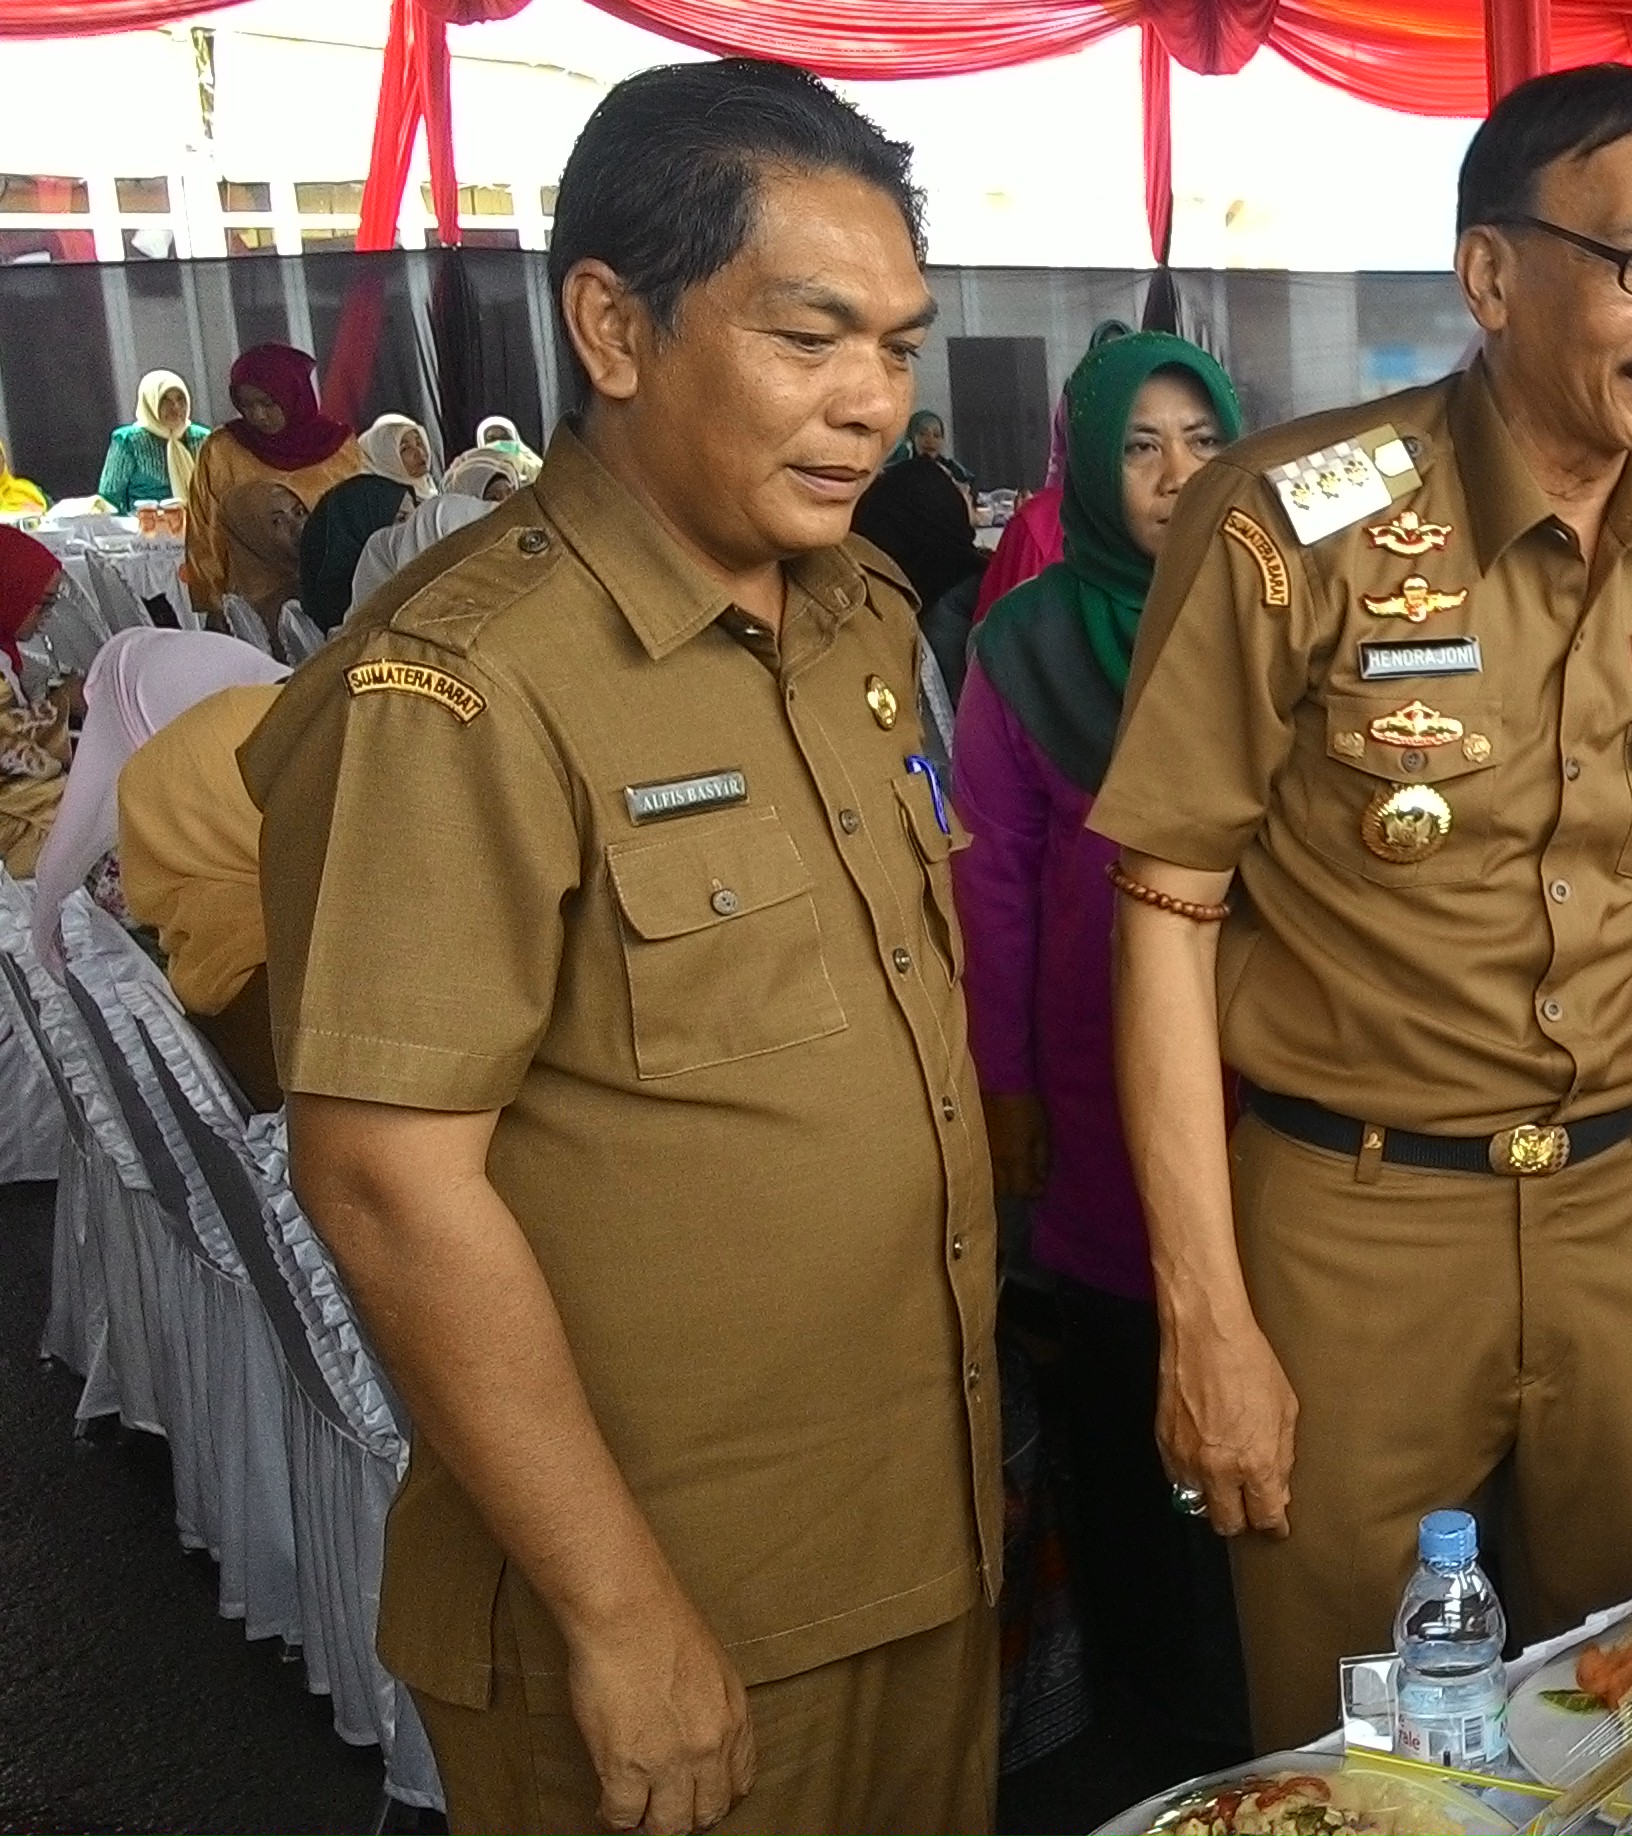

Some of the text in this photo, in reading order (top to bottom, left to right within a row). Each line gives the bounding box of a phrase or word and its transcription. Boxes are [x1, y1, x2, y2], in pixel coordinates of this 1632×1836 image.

[1368, 645, 1475, 669] HENDRAJONI
[350, 666, 482, 715] SUMATERA BARAT
[642, 788, 686, 812] ALFIS
